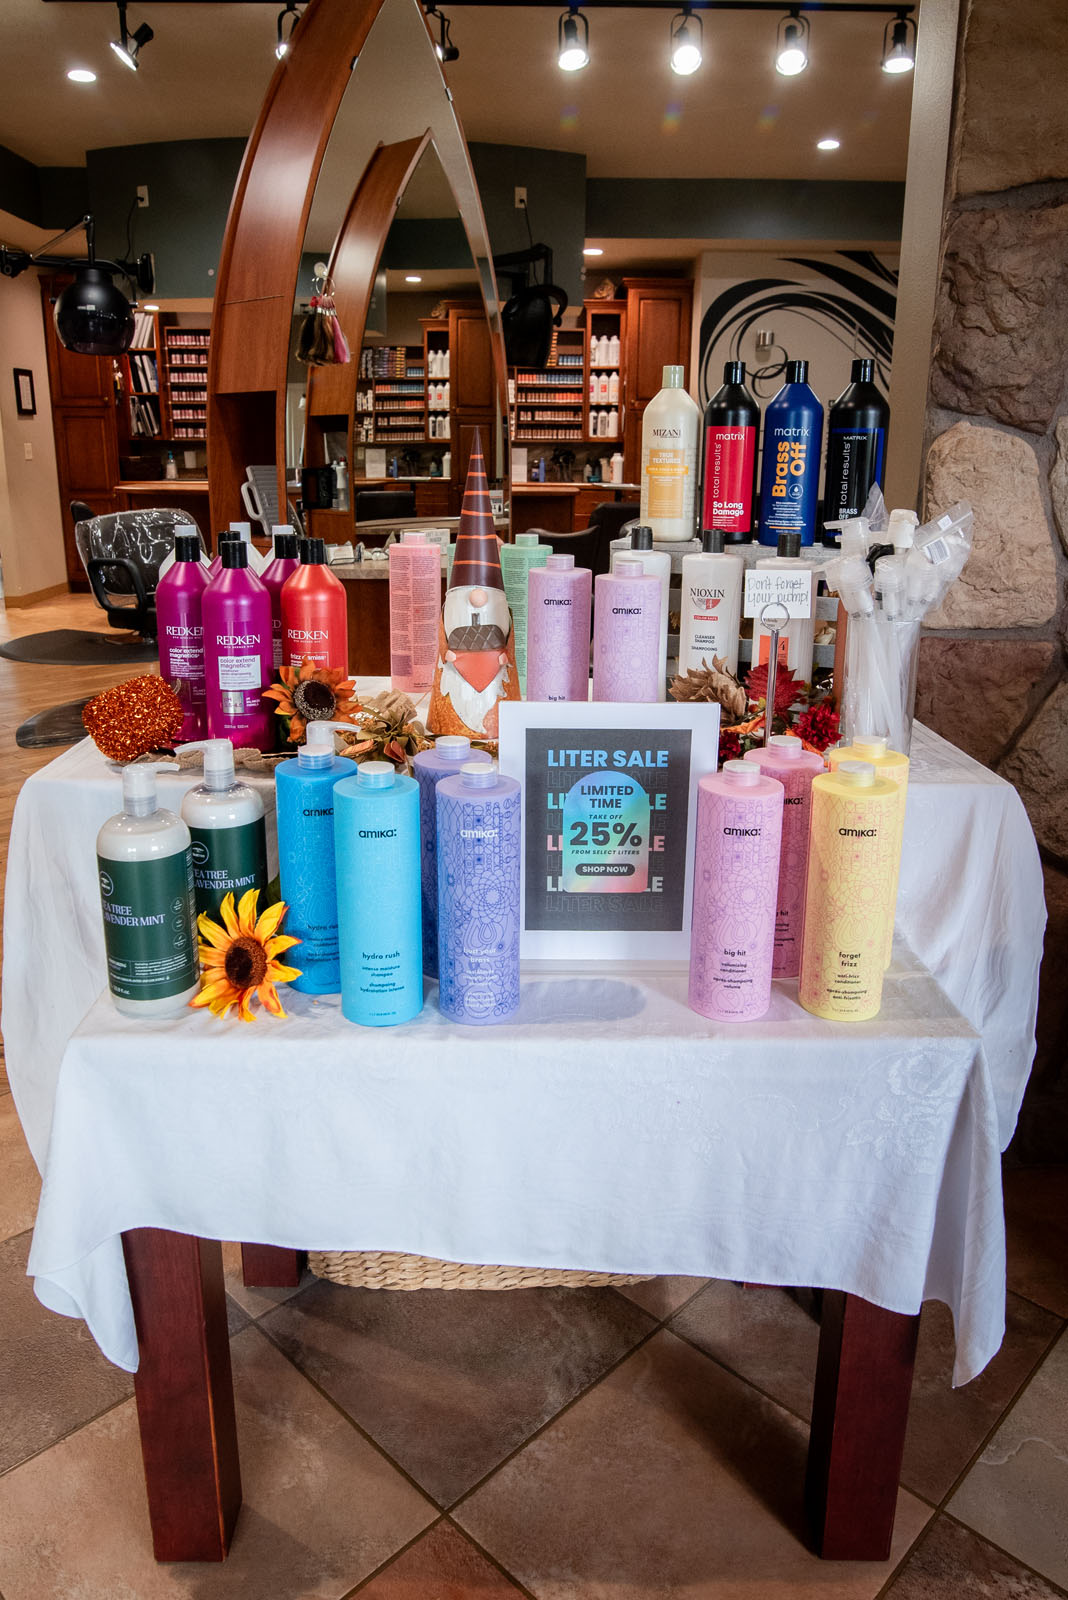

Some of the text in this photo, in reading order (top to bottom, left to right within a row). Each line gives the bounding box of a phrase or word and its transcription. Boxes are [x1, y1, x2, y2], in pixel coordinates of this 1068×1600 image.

[652, 429, 682, 437] MIZANI
[715, 432, 745, 440] matrix
[774, 427, 809, 437] matrix
[790, 442, 807, 477] Off
[772, 441, 790, 497] Brass
[840, 443, 851, 505] total results
[724, 501, 744, 510] Long
[713, 508, 744, 516] Damage
[748, 576, 804, 597] Don't forget
[690, 588, 725, 598] NIOXIN
[544, 597, 572, 606] amika:
[747, 592, 774, 607] your
[612, 607, 642, 615] amika:
[216, 633, 261, 646] REDKEN
[287, 629, 328, 640] REDKEN
[547, 750, 669, 768] LITER SALE
[580, 785, 634, 796] LIMITED
[589, 798, 622, 809] TIME
[358, 828, 397, 839] amika:
[460, 828, 498, 838] amika:
[569, 821, 642, 847] 25%
[723, 827, 761, 837] amika:
[838, 827, 878, 837] amika:
[193, 869, 228, 880] EA TREE
[194, 874, 256, 889] AVENDER MINT
[103, 900, 133, 915] EA TREE
[139, 913, 166, 927] MINT
[362, 949, 400, 960] hydro rush
[723, 949, 736, 957] big
[838, 951, 861, 960] forget
